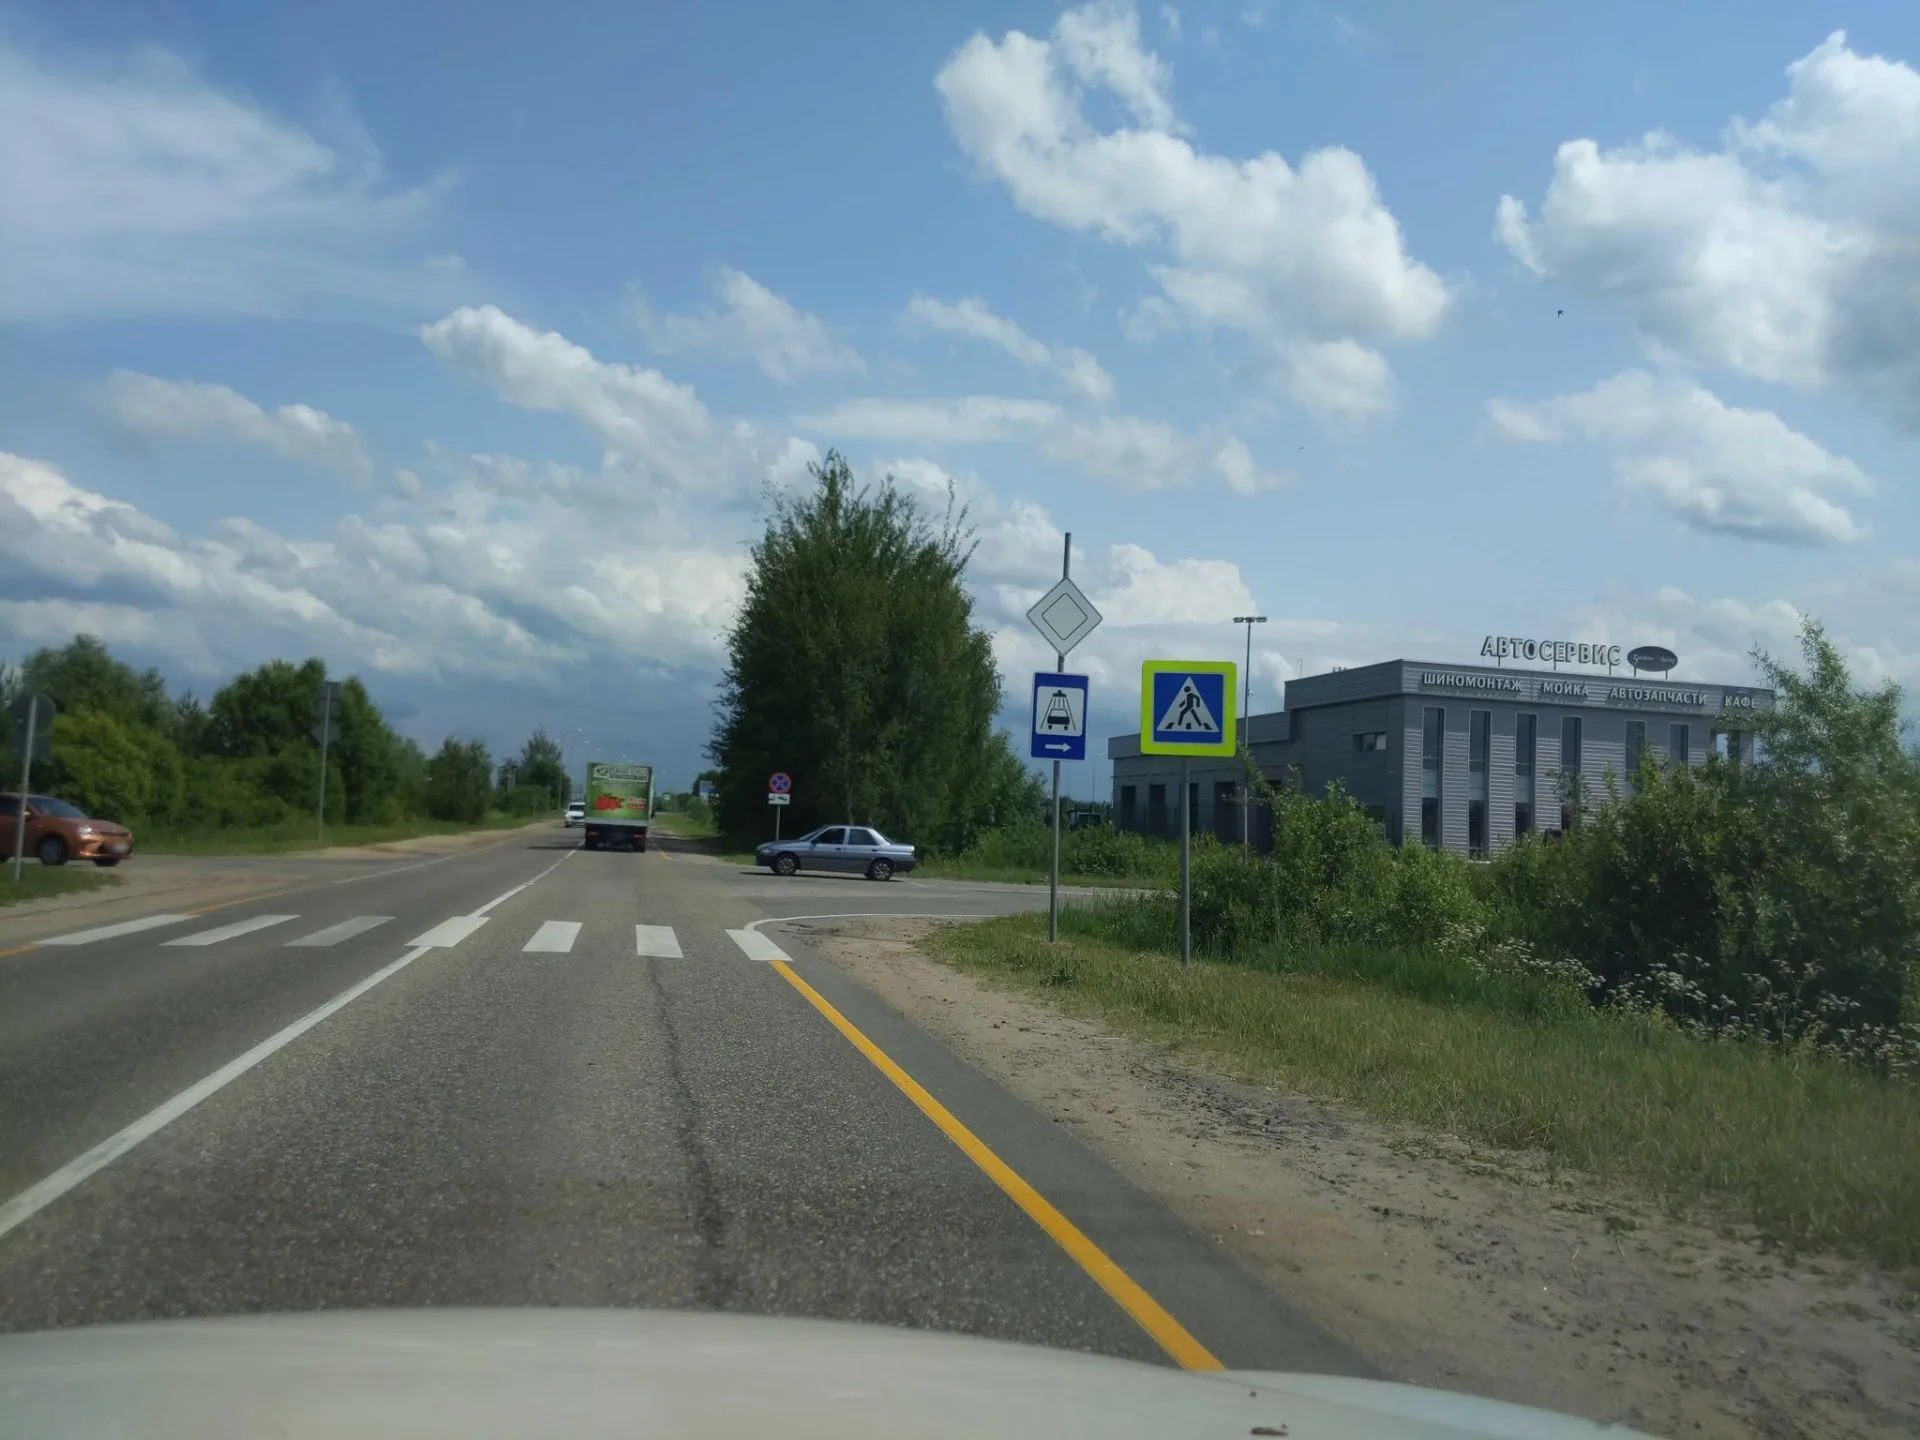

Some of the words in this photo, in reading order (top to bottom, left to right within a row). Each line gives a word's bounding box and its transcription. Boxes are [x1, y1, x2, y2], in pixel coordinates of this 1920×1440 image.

[1481, 635, 1621, 666] АВТОСЕРВИС
[1422, 672, 1523, 691] ШИНОМОНТАЖ
[1610, 687, 1707, 705] АВТОЗАПЧАСТИ
[1725, 696, 1756, 709] КАФЕ
